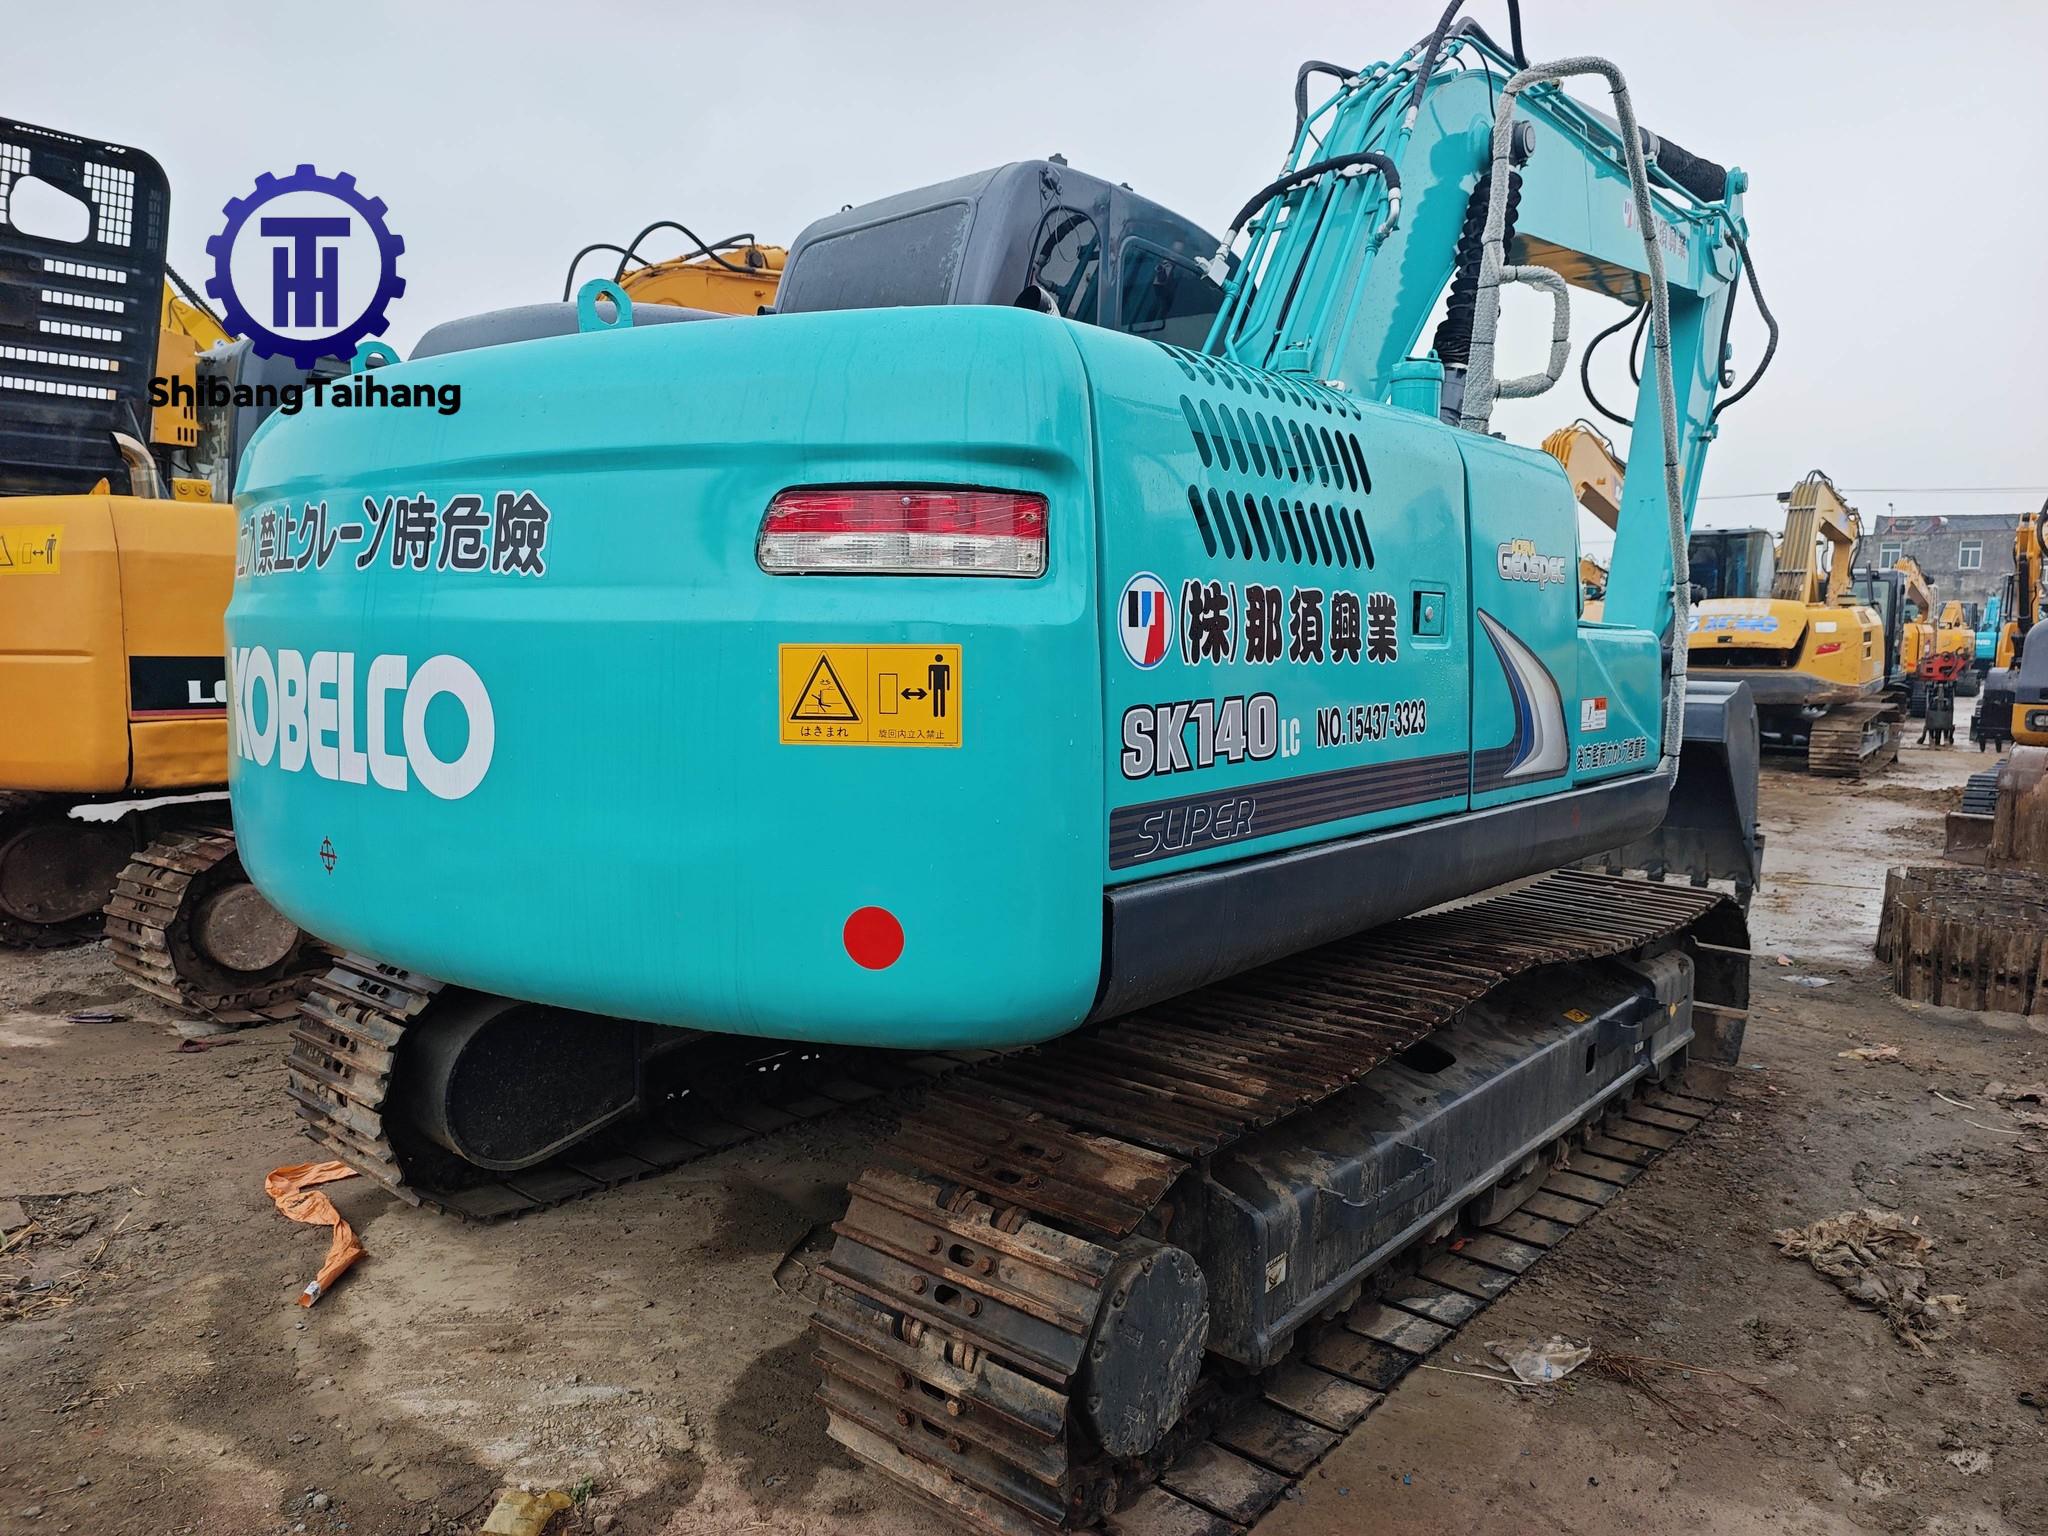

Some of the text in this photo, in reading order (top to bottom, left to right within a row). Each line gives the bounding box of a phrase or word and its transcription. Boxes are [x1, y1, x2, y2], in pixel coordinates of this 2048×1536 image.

[231, 645, 496, 800] KOBELCO
[1121, 692, 1278, 780] SK140
[1281, 718, 1301, 758] LC
[1133, 798, 1257, 858] SUPER
